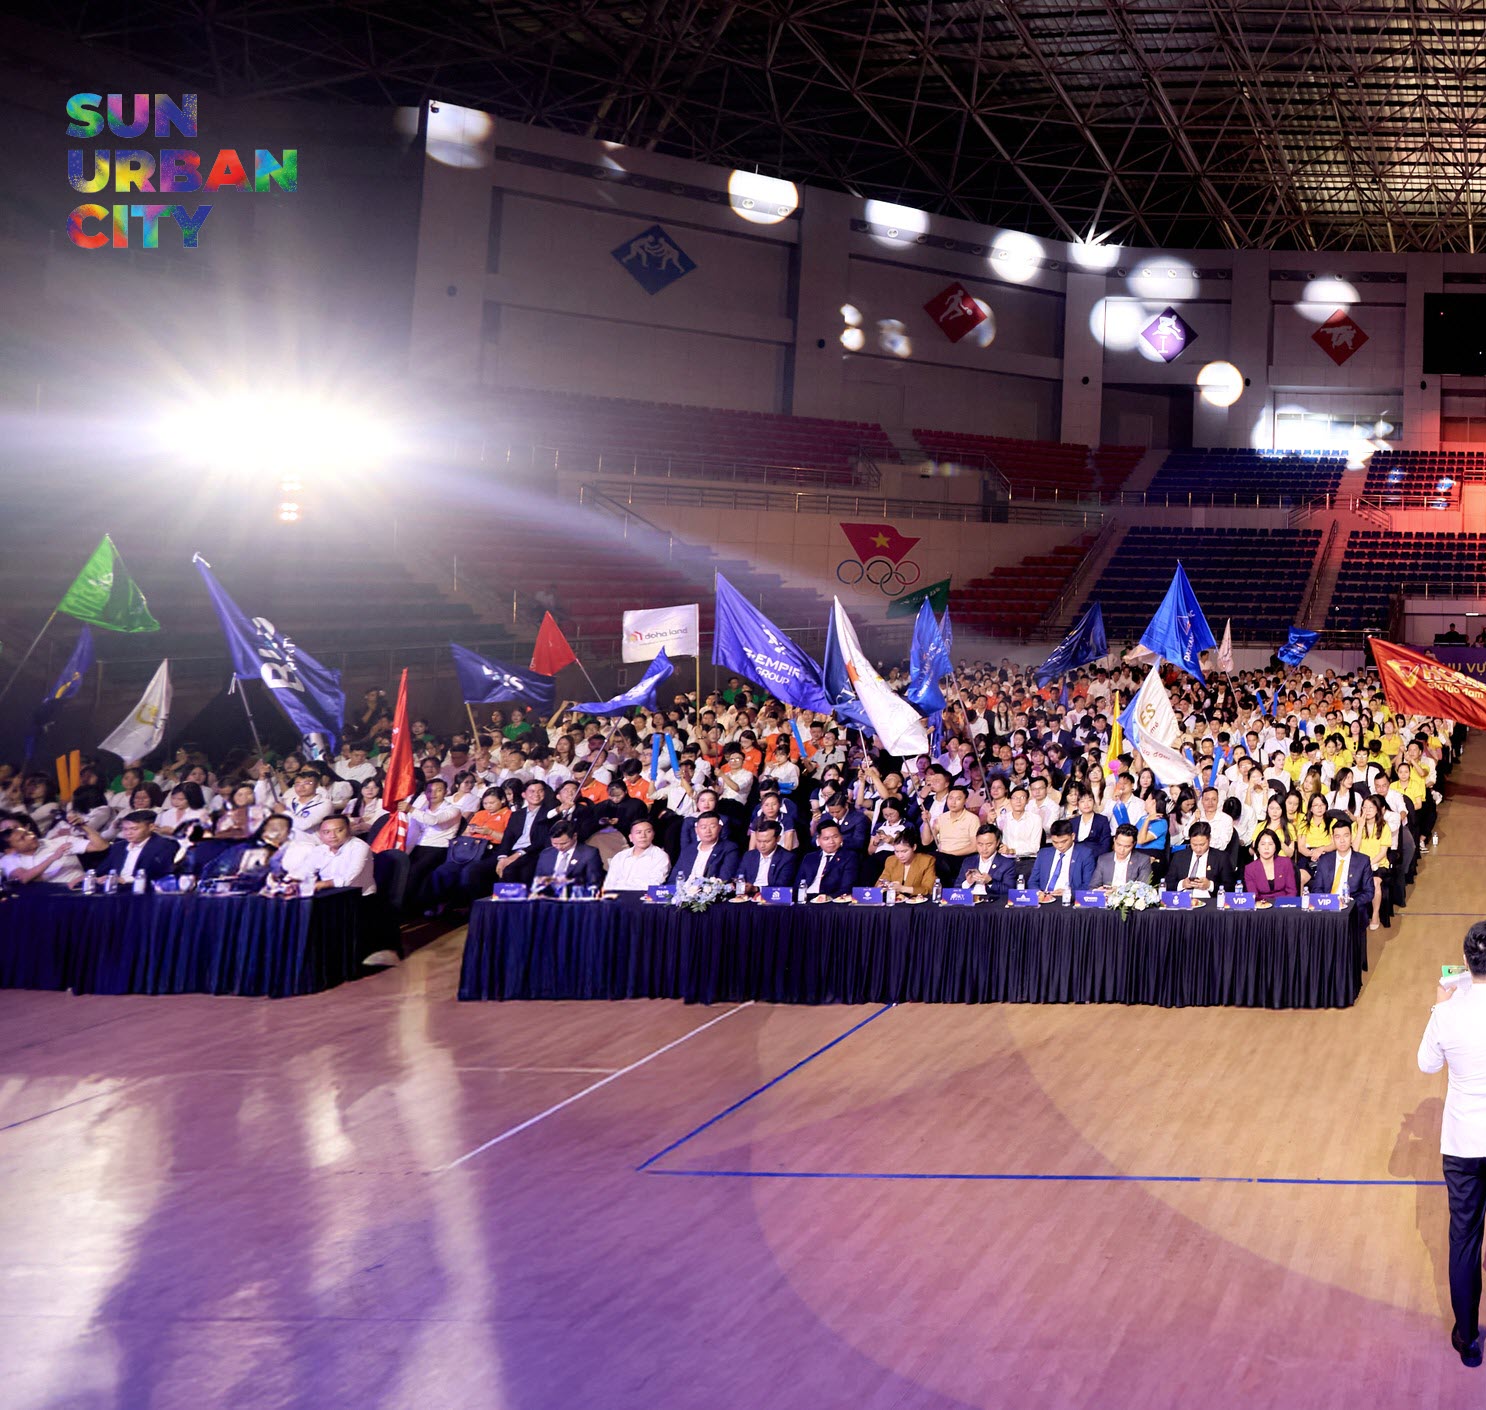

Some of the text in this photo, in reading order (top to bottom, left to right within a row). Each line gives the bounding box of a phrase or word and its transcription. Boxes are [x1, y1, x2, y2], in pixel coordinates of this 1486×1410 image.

[755, 666, 790, 685] GROUP
[1233, 897, 1247, 905] VIP
[1317, 898, 1332, 906] VIP
